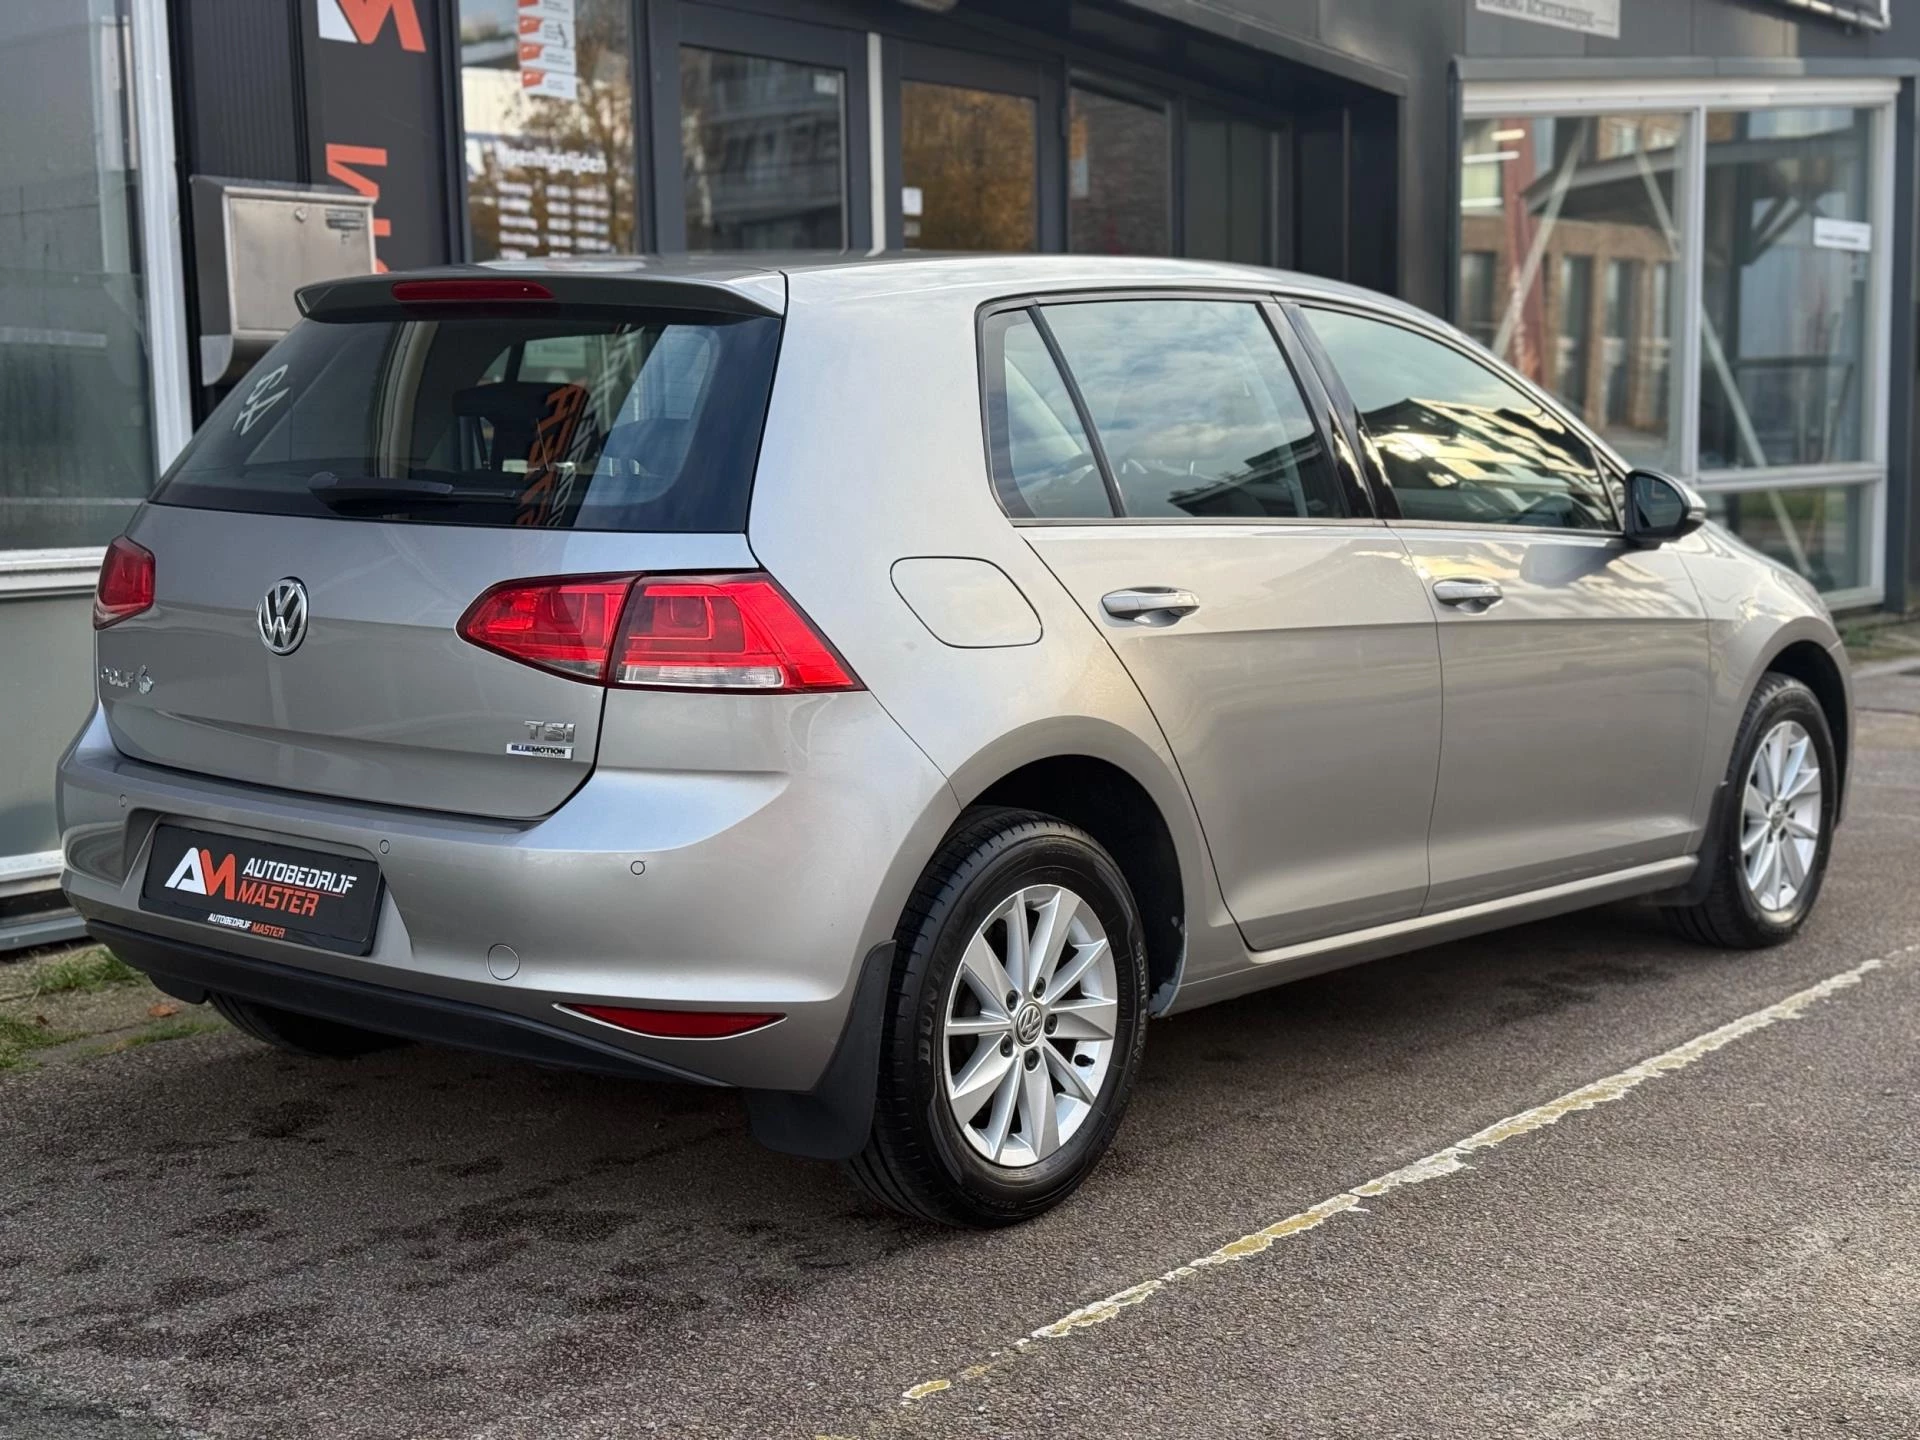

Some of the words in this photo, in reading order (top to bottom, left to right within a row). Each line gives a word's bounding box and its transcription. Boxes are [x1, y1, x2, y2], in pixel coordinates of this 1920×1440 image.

[523, 720, 576, 743] TSI
[511, 744, 566, 755] BLUEMOTION
[242, 857, 358, 895] AUTOBEDRIJF
[236, 880, 320, 917] MASTER
[207, 912, 252, 930] AUTOBEDRIJF
[251, 922, 287, 939] MASTER
